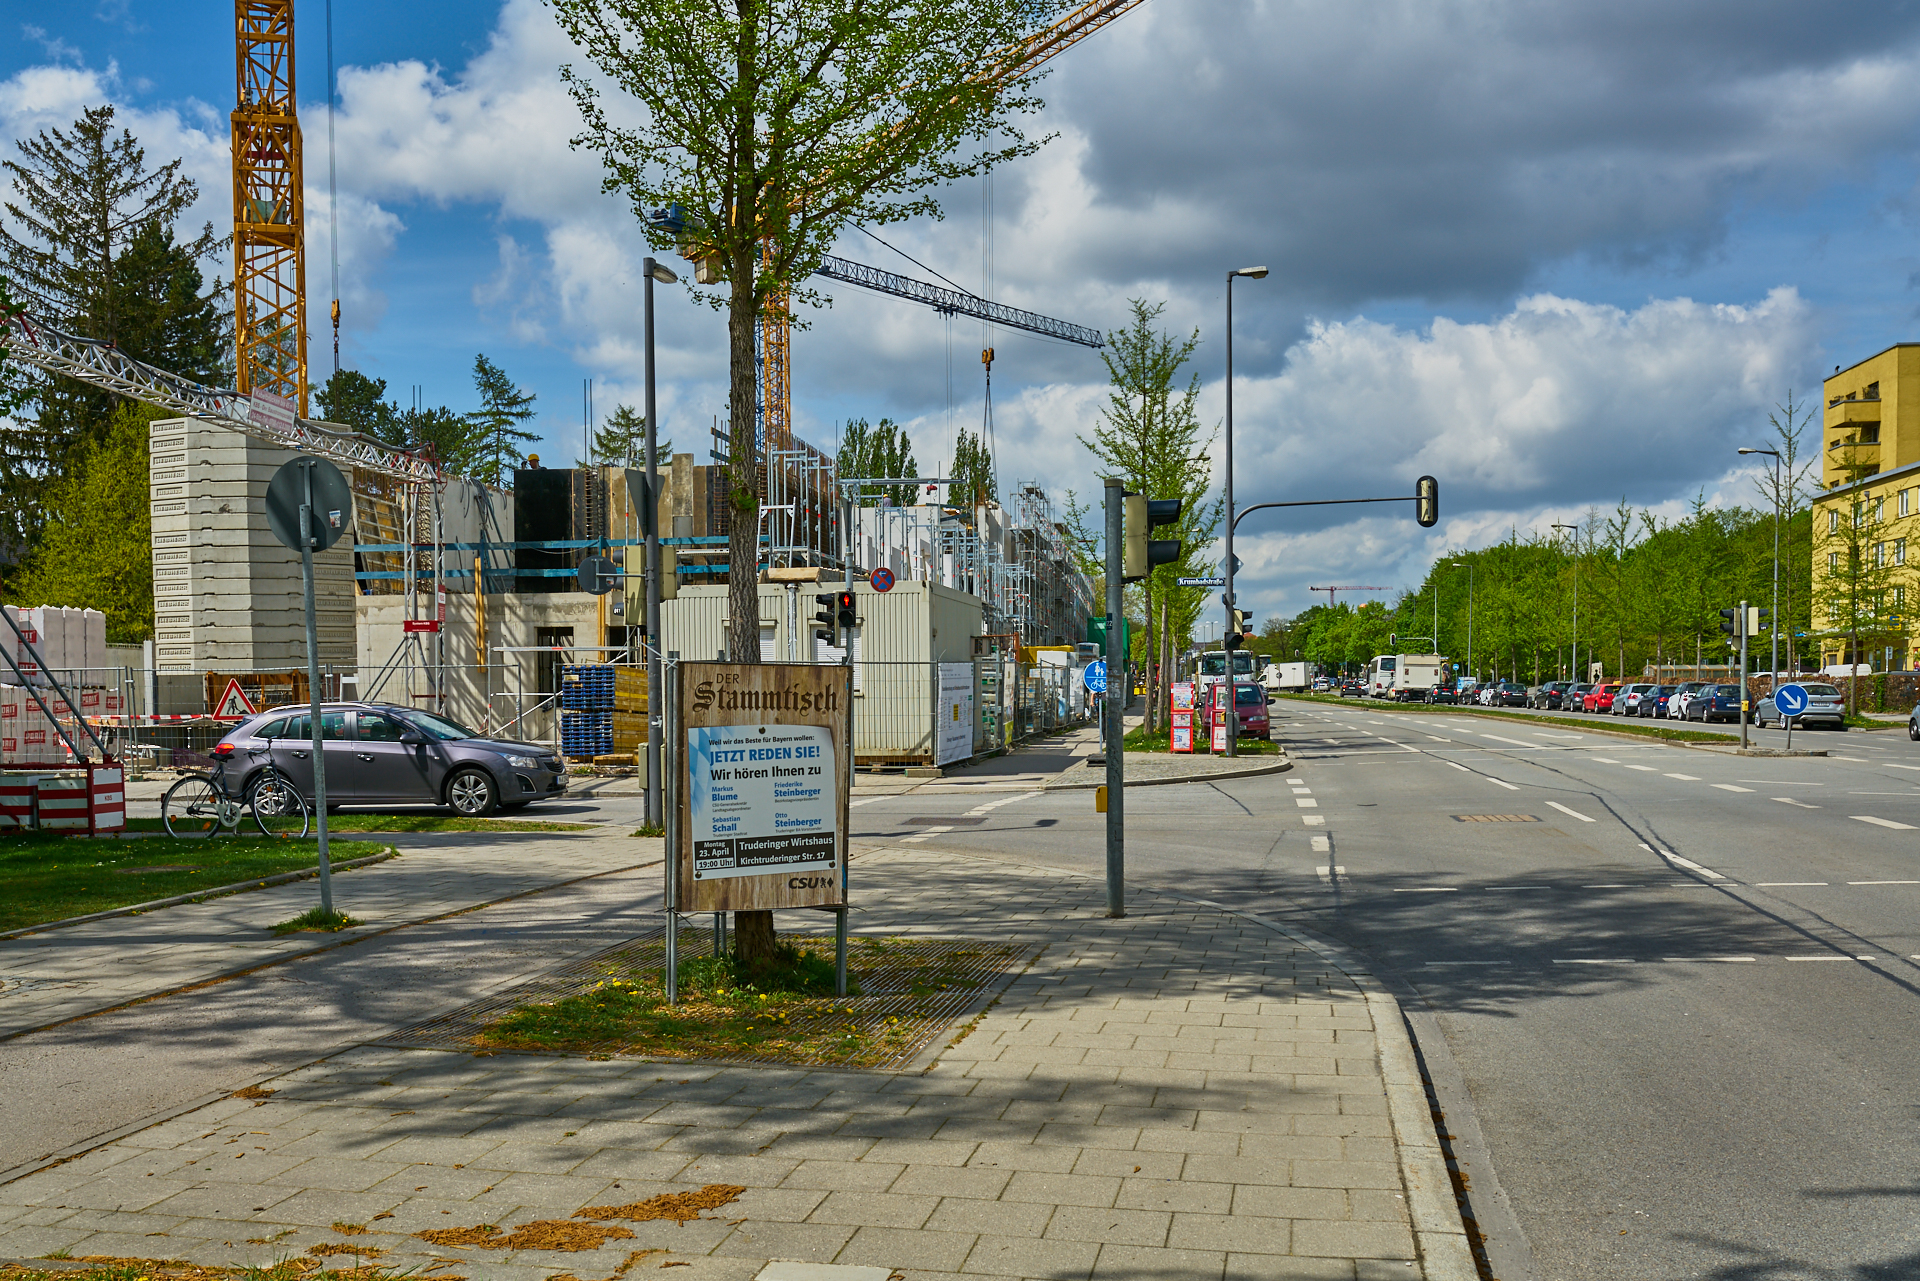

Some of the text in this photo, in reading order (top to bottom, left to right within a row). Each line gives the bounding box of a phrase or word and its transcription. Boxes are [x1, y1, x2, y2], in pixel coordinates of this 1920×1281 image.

[1179, 578, 1224, 586] Krumbadstraße
[716, 673, 740, 684] DER
[692, 681, 838, 717] Stammtisch
[772, 736, 793, 744] Bayern
[710, 745, 820, 766] JETZT REDEN SIE!
[710, 765, 821, 781] Wir hören Ihnen zu
[711, 793, 738, 802] Blume
[774, 788, 821, 798] Steinberger
[712, 823, 737, 833] Schall
[775, 818, 822, 828] Steinberger
[739, 837, 833, 851] Truderinger Wirtshaus
[699, 848, 730, 857] 23. April
[720, 859, 733, 867] Uhr
[740, 851, 826, 866] Kirchtruderinger Str. 17
[788, 877, 820, 889] CSU
